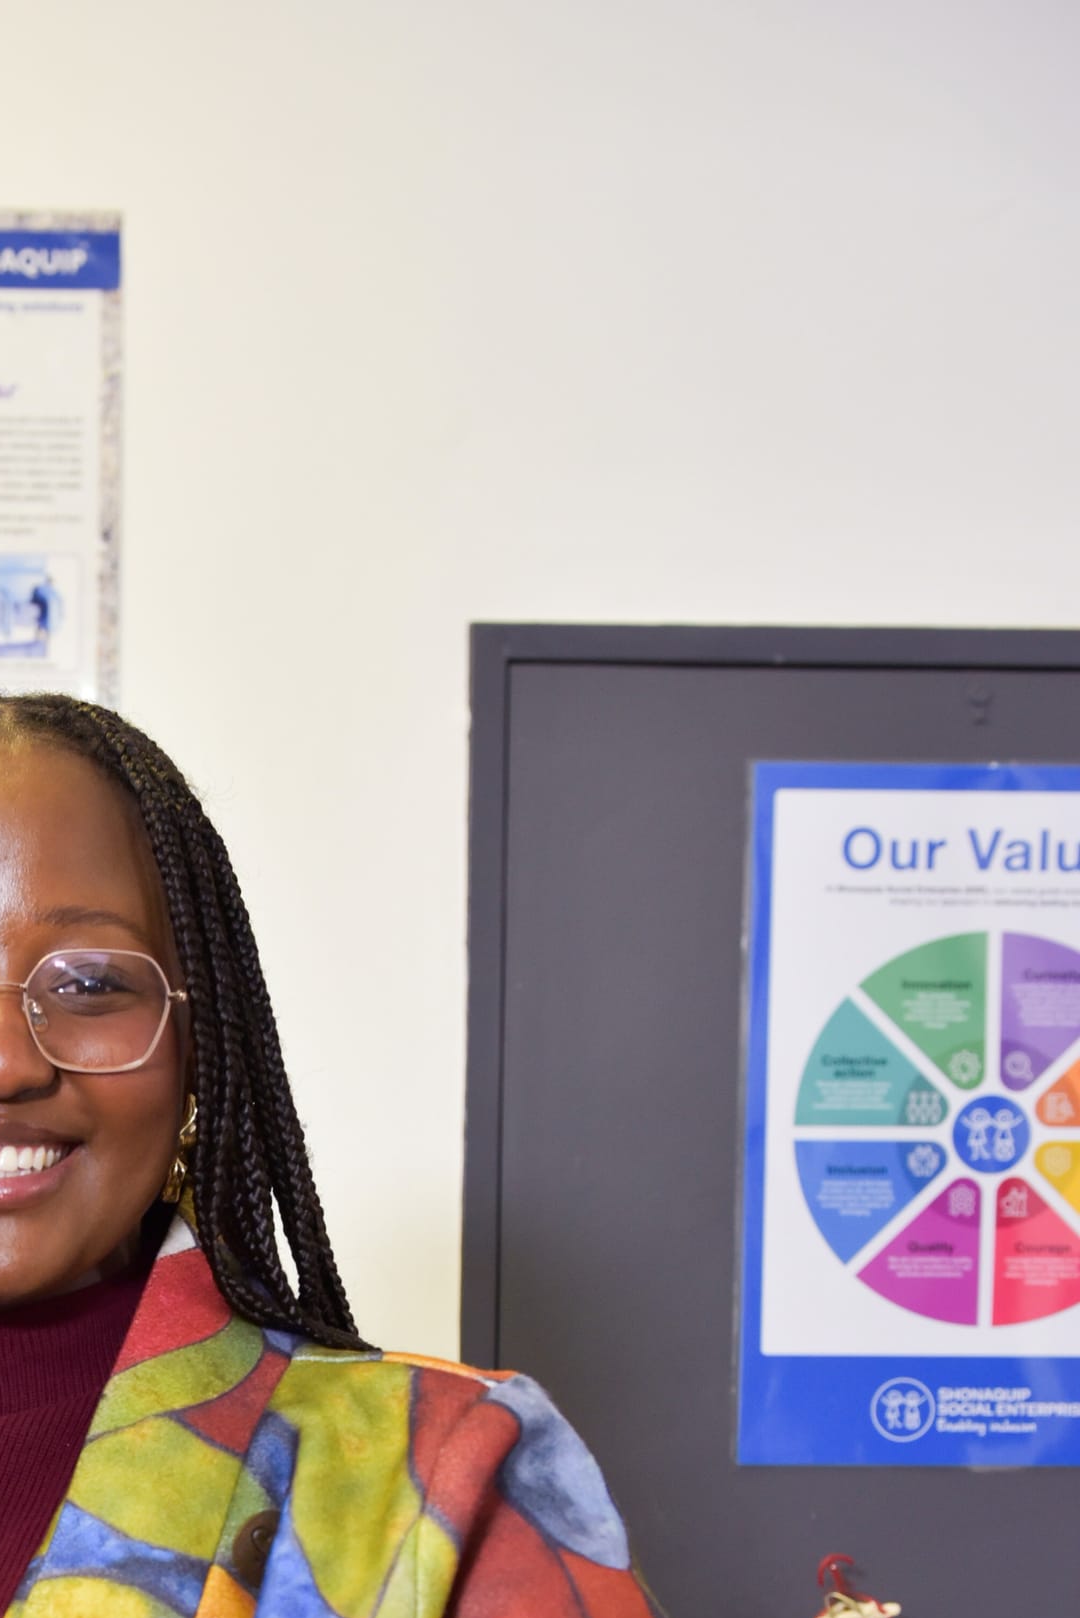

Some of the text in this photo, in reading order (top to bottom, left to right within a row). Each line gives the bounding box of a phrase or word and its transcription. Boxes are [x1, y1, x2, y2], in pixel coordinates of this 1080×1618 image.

[843, 826, 948, 871] Our
[937, 1387, 1032, 1402] SHONAQUIP
[937, 1402, 994, 1417] SOCIAL
